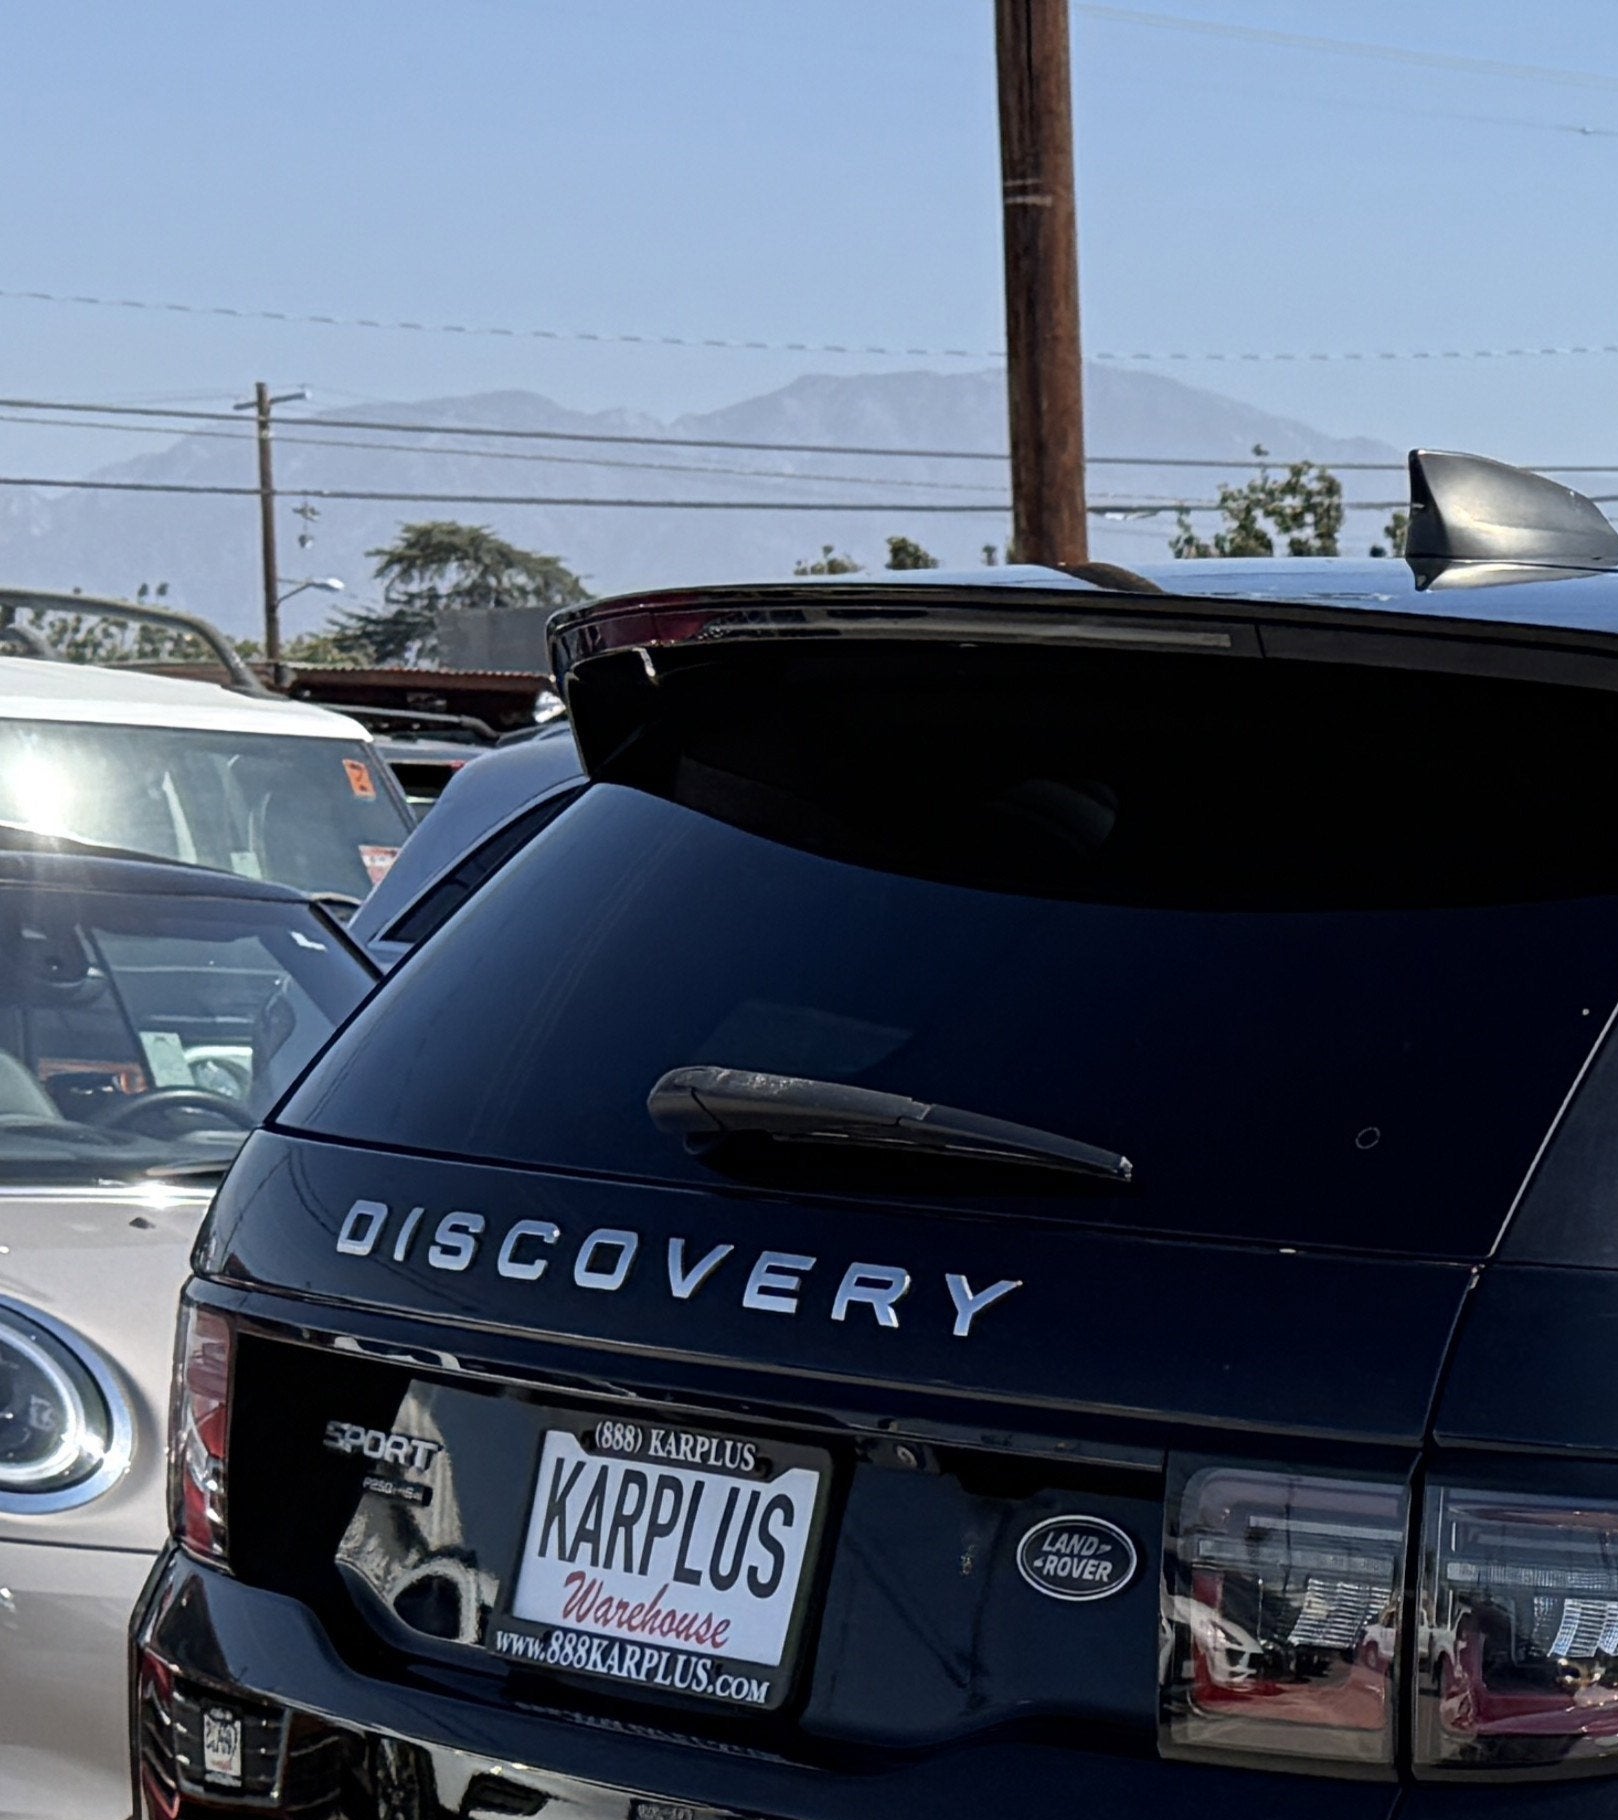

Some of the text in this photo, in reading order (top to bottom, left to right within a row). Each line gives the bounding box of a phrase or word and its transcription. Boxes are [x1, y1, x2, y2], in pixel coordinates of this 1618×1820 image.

[336, 1199, 1022, 1337] DISCOVERY
[323, 1420, 439, 1471] SPORT
[594, 1421, 757, 1472] (888) KARPLUS
[537, 1457, 795, 1599] KARPLUS
[562, 1570, 732, 1649] Warehouse
